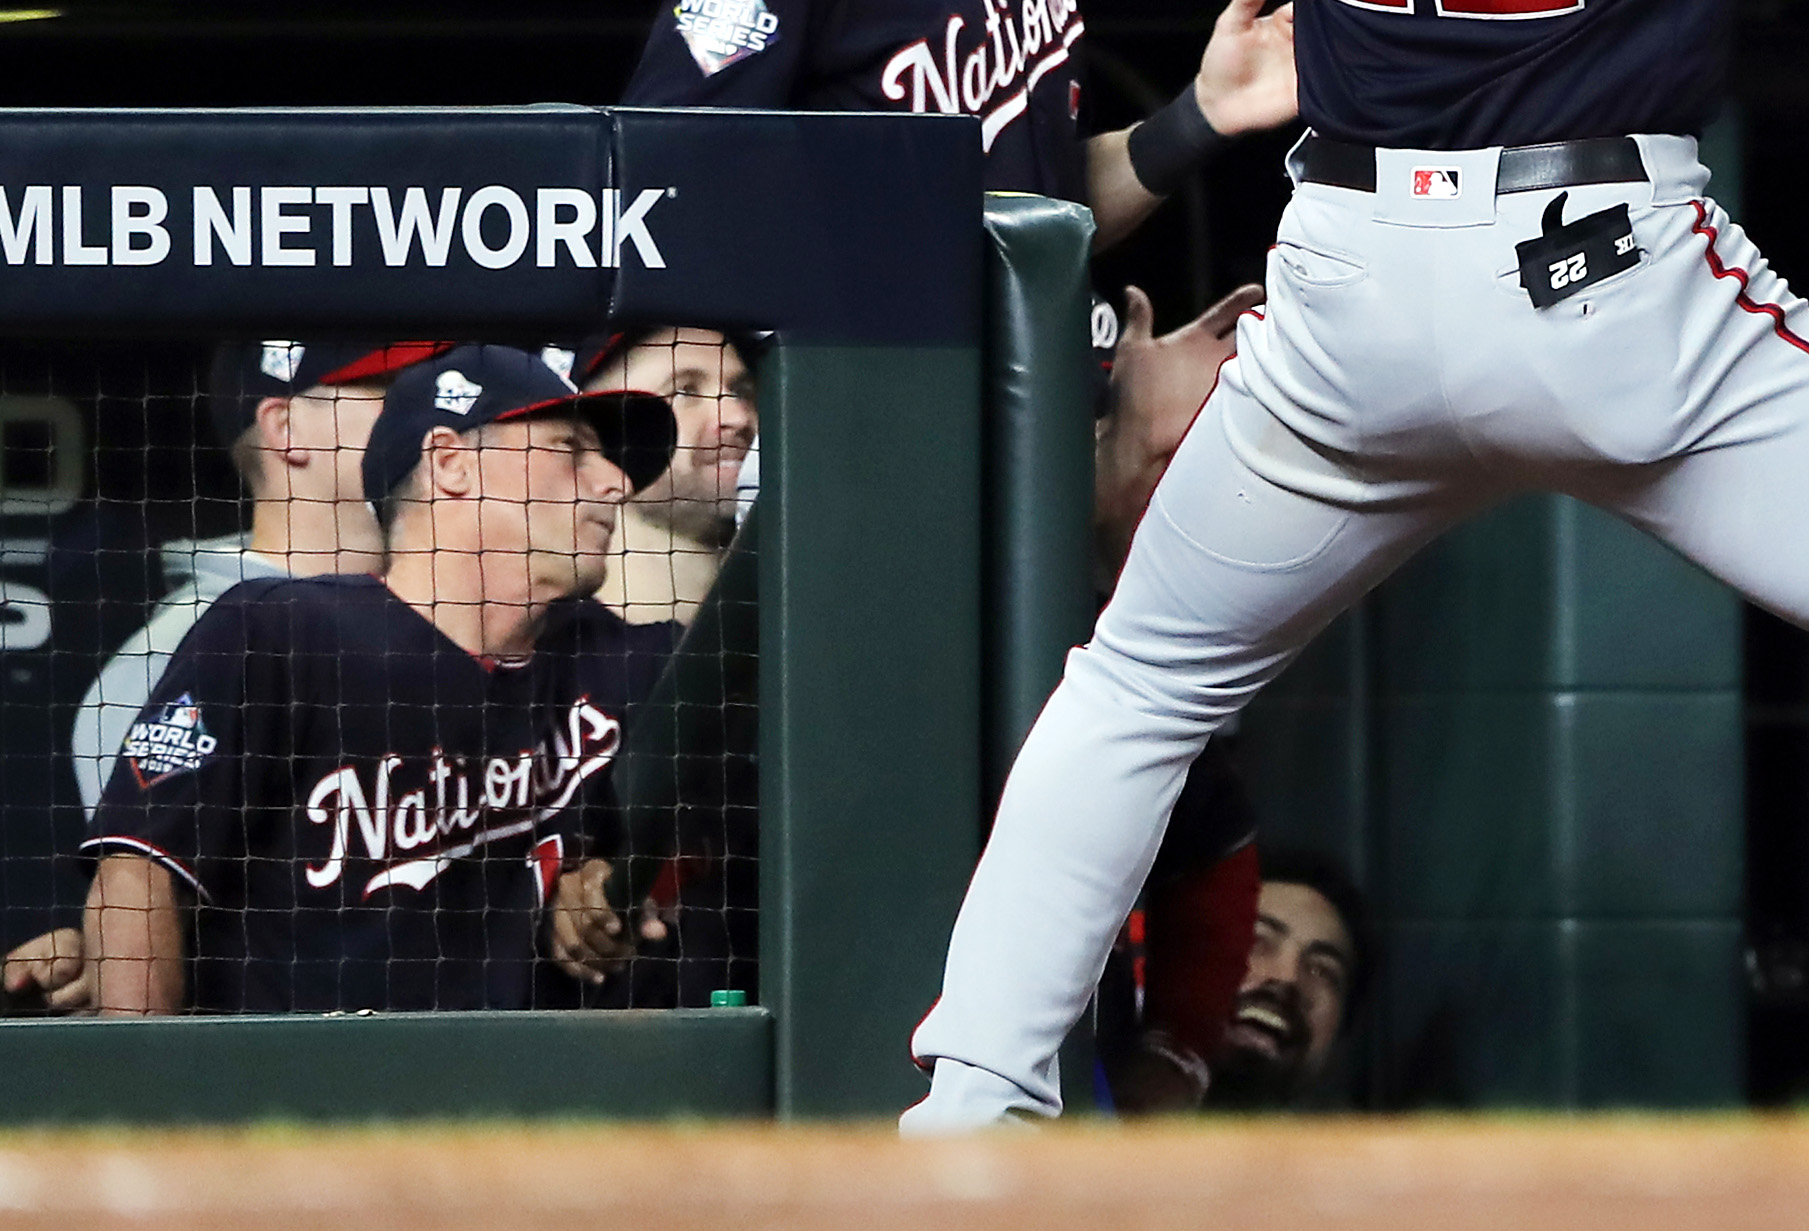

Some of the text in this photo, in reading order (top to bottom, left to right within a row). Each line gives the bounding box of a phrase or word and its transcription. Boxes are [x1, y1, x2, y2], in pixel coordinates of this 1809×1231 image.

[676, 12, 768, 52] SERIES
[0, 185, 667, 268] MLB NETWORK
[130, 721, 218, 757] WORLD
[305, 696, 621, 888] Nationals
